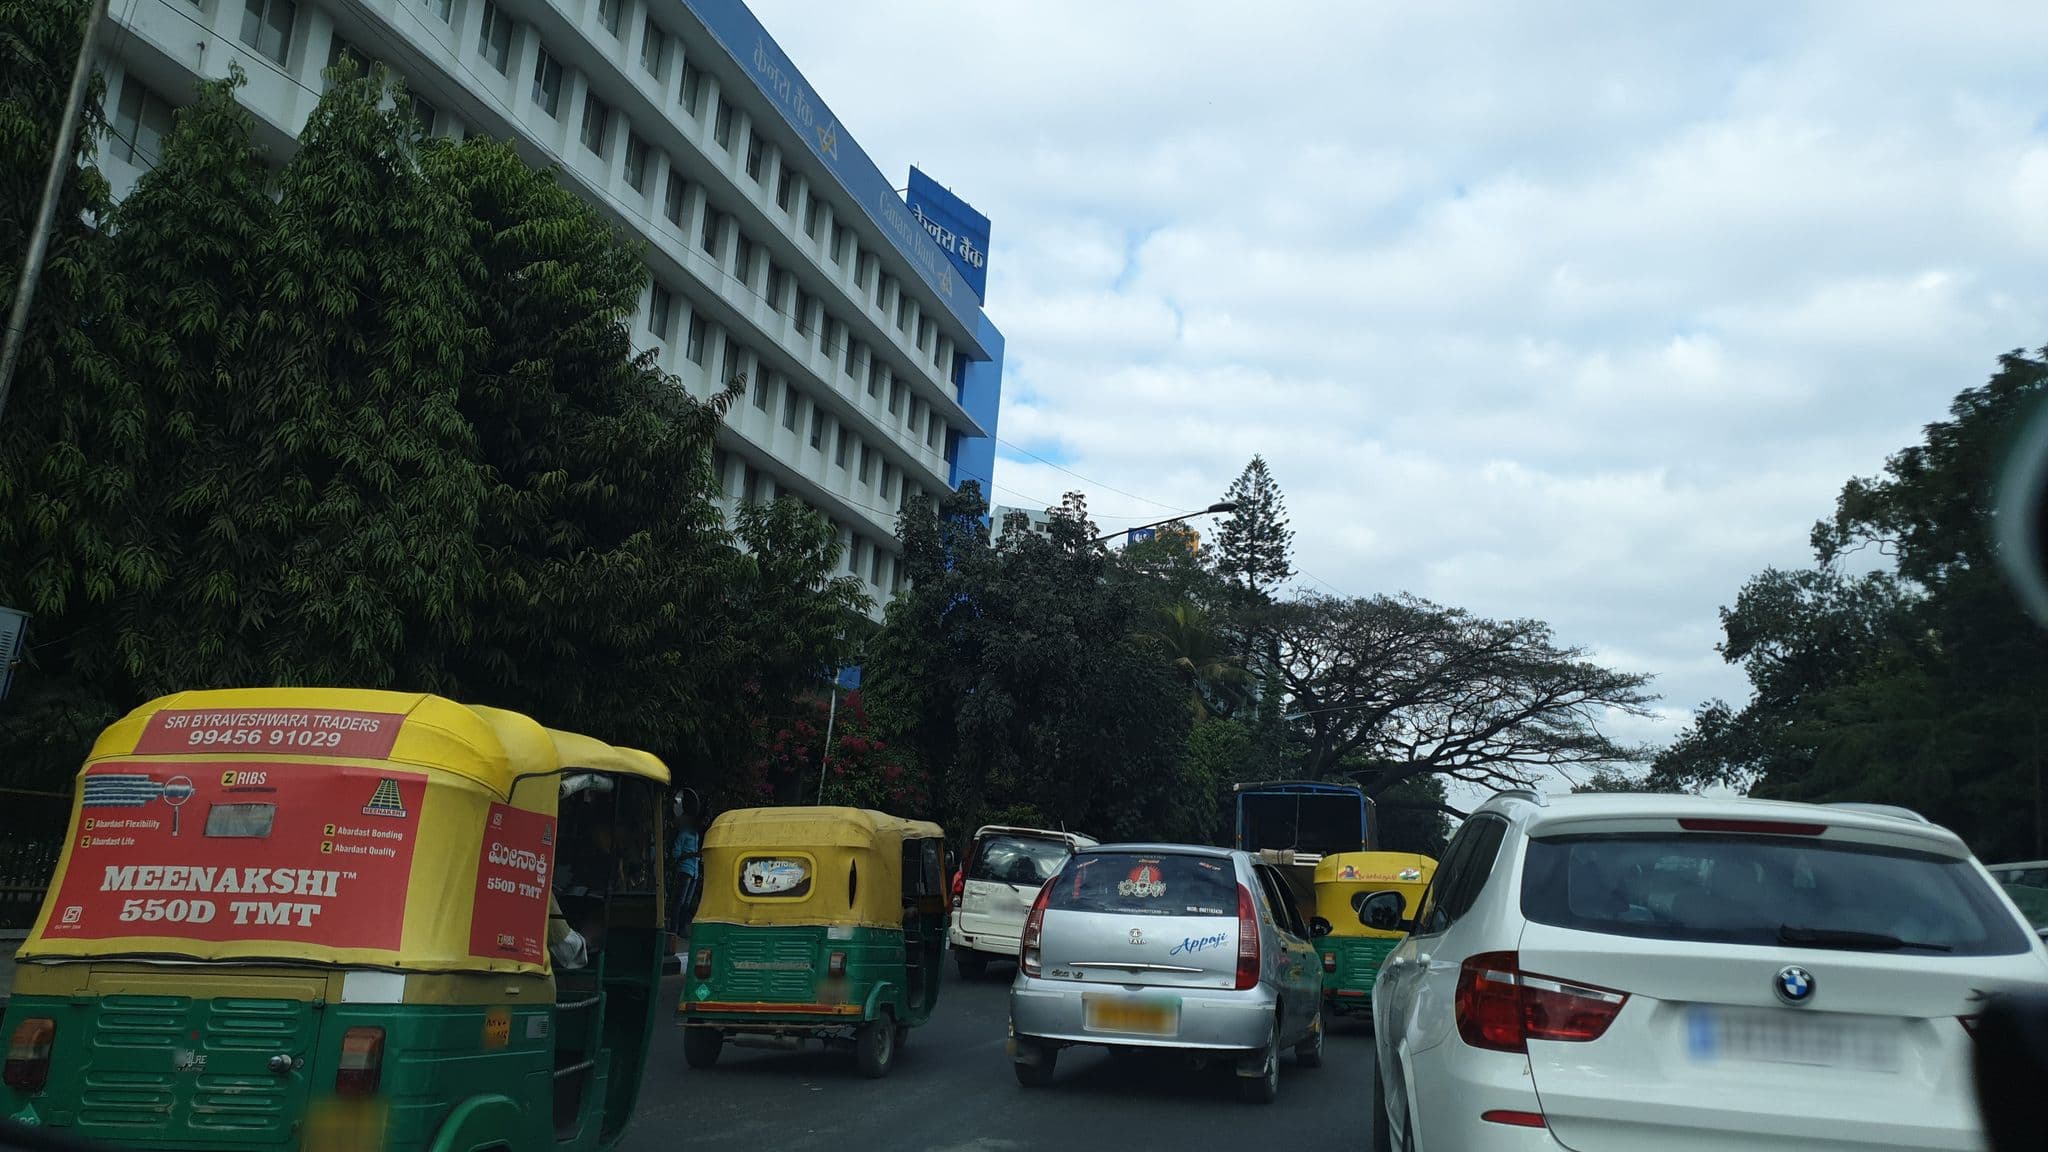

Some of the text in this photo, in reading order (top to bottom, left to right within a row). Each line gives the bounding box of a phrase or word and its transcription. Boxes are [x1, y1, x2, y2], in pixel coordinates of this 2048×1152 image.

[880, 191, 936, 273] Canara Bank
[165, 713, 380, 733] SRI BYRAVESHWARA TRADERS
[188, 730, 342, 747] 99456 91029
[237, 771, 268, 786] RIBS
[371, 829, 403, 841] Bonding
[369, 846, 396, 858] Quality
[100, 865, 340, 897] MEENAKSHI
[487, 877, 542, 899] 550D TMT
[119, 899, 321, 927] 550D TMT
[1170, 932, 1228, 955] Appaji
